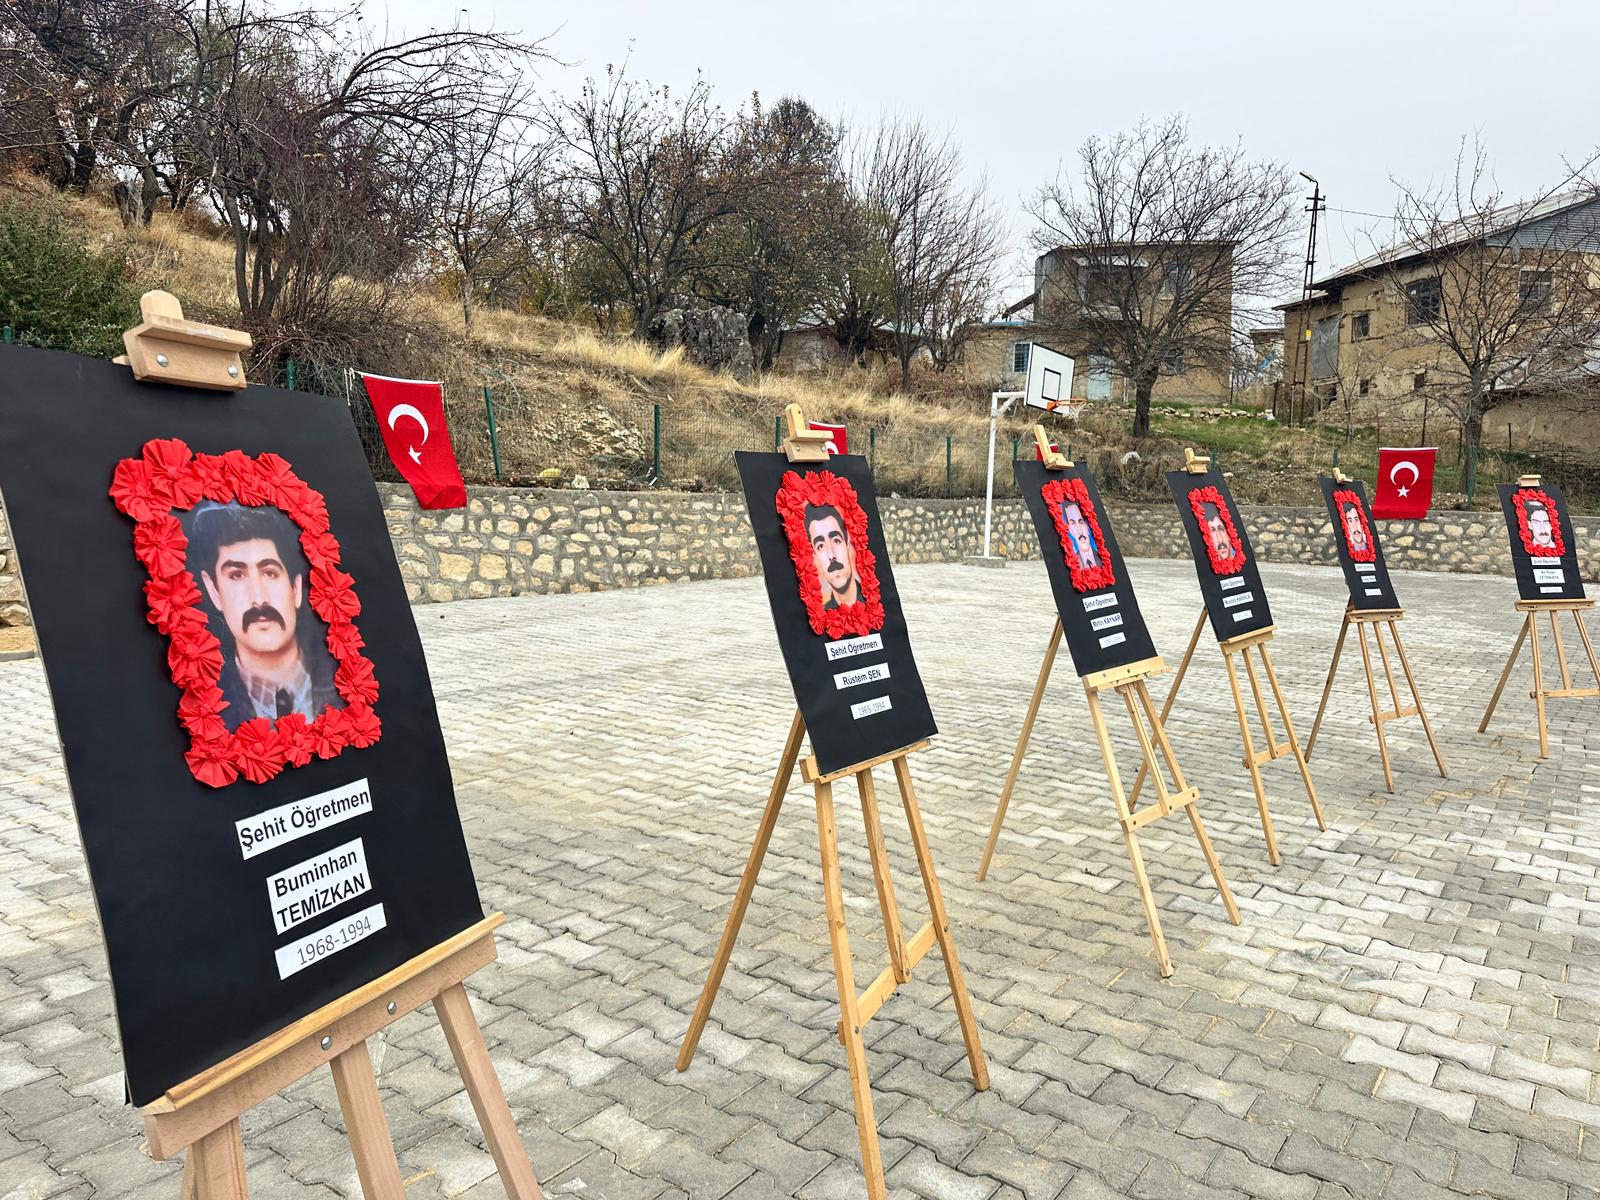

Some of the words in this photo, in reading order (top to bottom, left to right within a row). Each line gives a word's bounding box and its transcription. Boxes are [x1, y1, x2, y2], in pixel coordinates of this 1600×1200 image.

[830, 646, 847, 658] Şehit
[847, 640, 878, 654] Öğretmen
[842, 672, 868, 685] Rüstem
[867, 669, 882, 680] ŞEN
[240, 816, 287, 851] Şehit
[291, 790, 370, 829] Öğretmen
[274, 851, 358, 898] Buminhan
[277, 872, 366, 928] TEMİZKAN
[297, 916, 372, 965] 1968-1994
